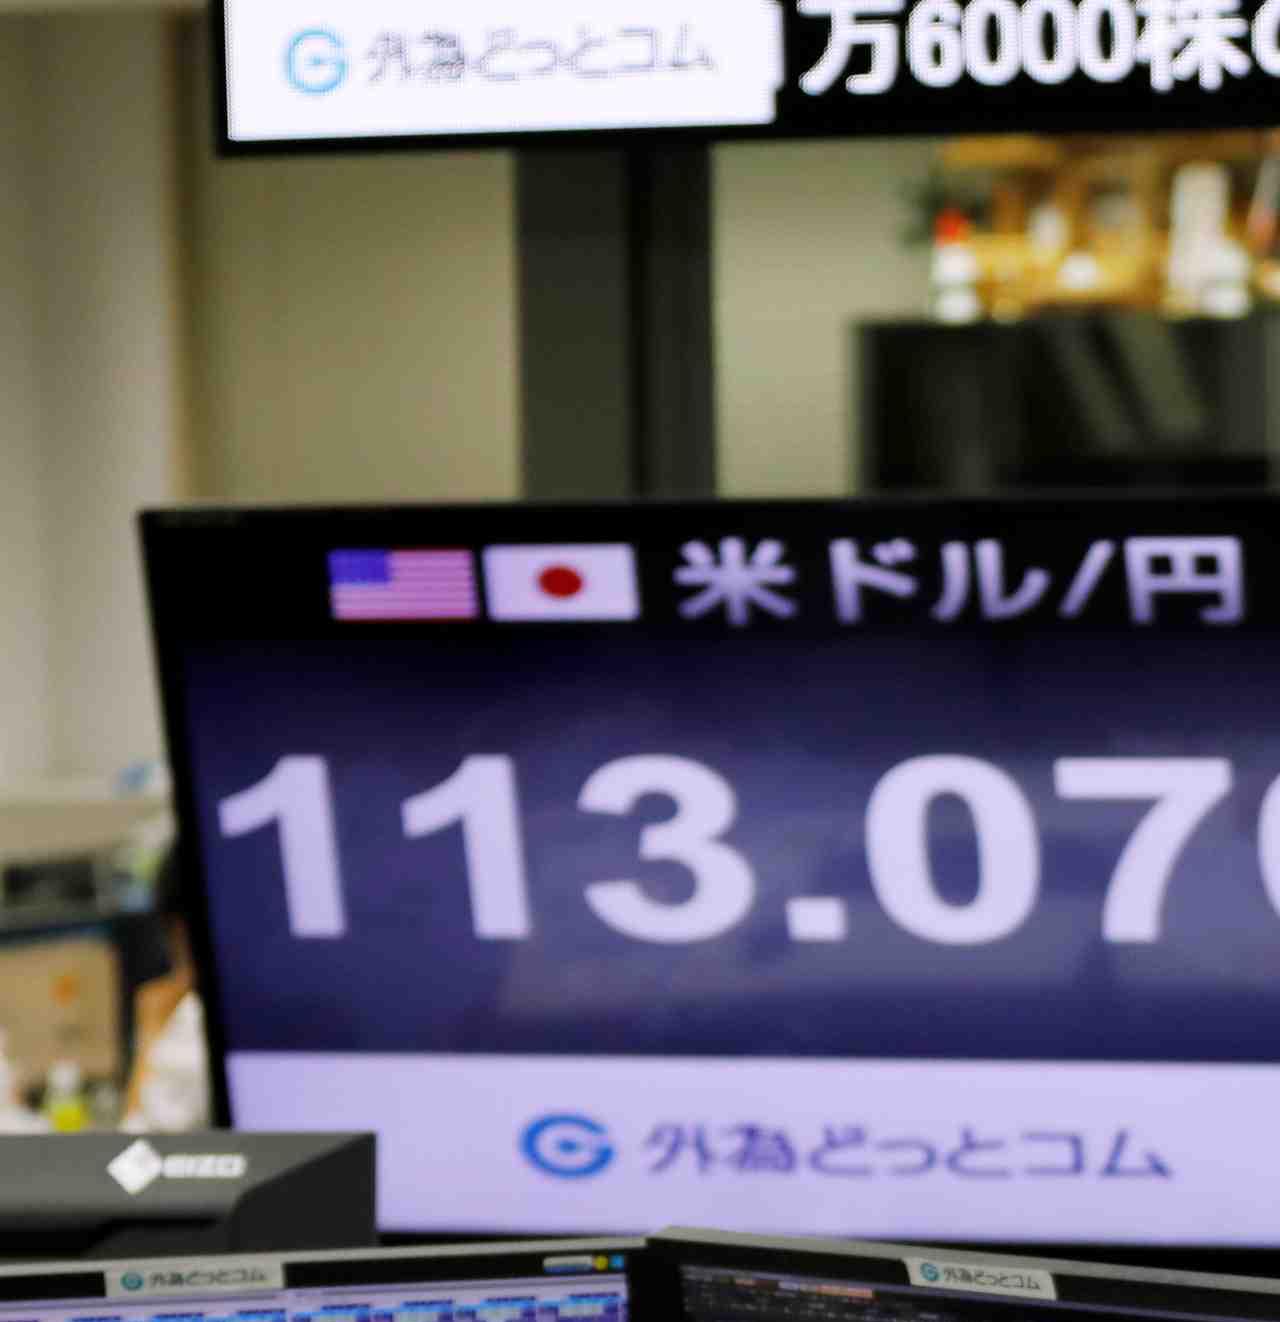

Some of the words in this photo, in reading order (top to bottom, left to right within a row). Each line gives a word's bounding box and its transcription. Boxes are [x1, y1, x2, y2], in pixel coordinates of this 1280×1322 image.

[645, 1121, 1174, 1180] 外為どっとコム
